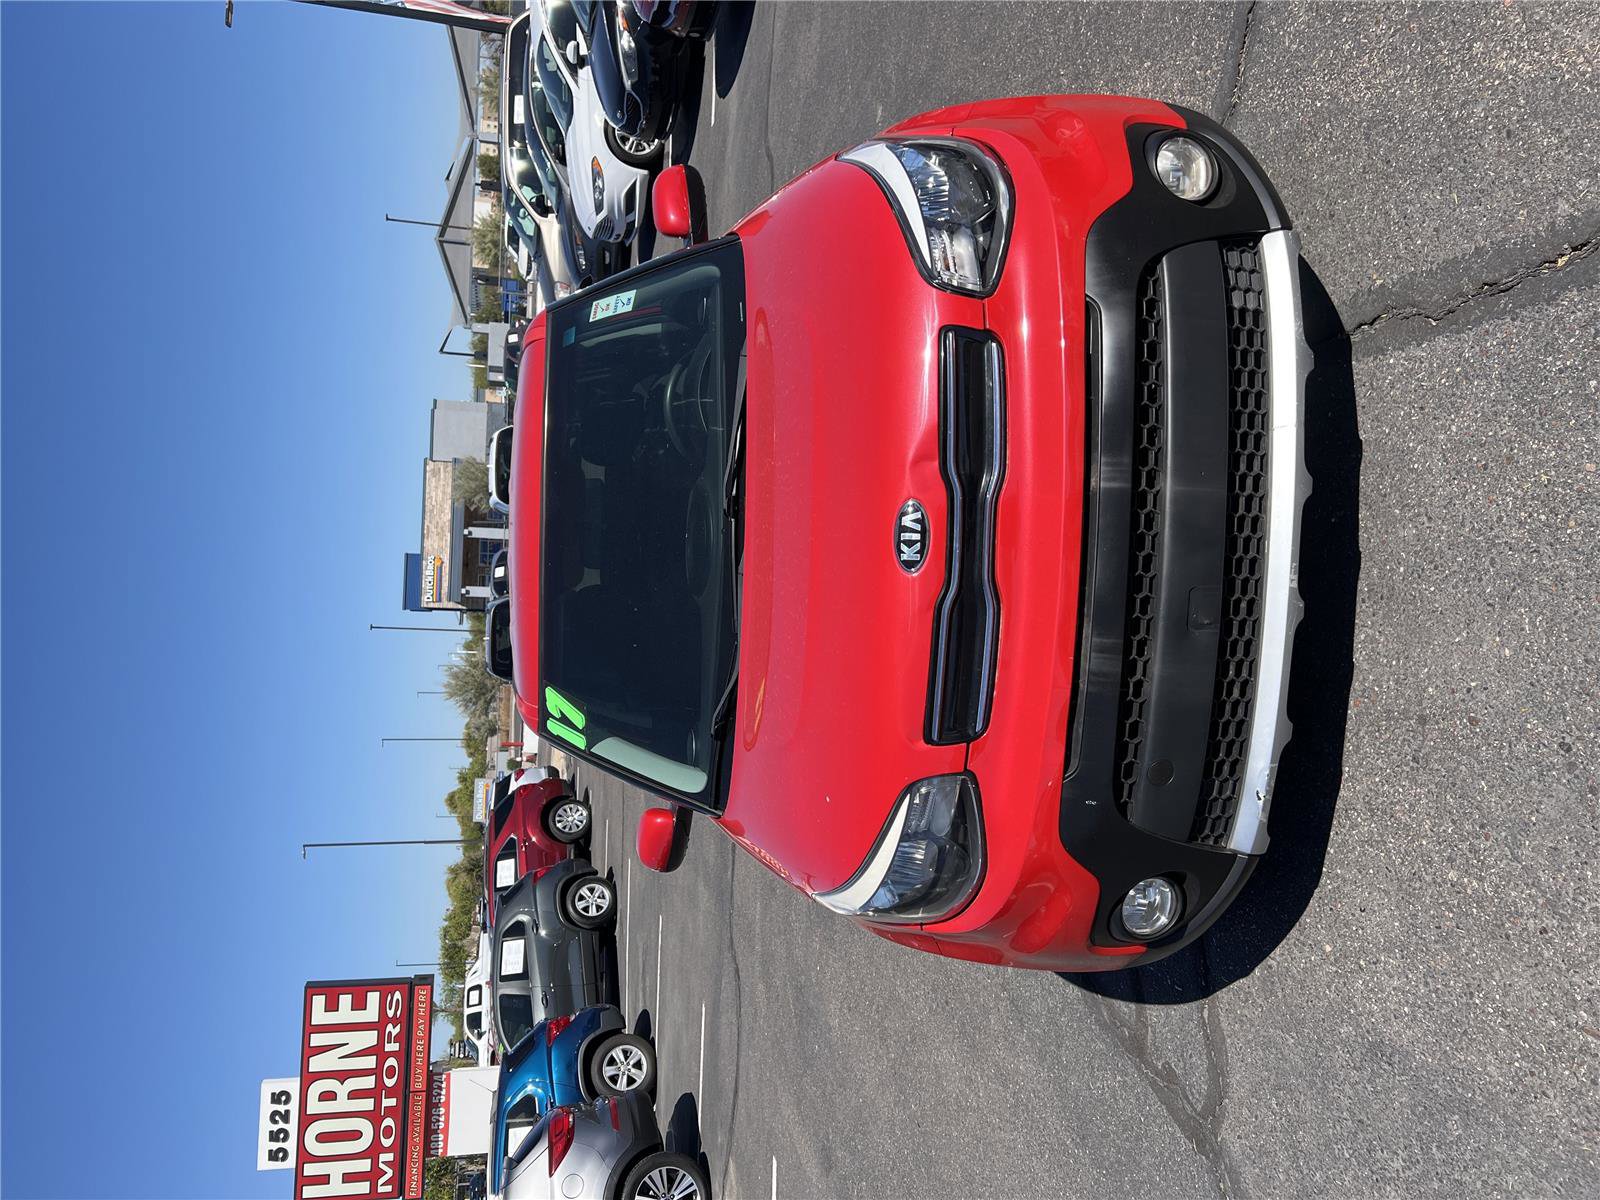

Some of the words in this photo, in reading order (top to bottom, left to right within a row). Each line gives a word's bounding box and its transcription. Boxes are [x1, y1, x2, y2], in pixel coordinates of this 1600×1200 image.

[545, 686, 587, 751] 17
[416, 1017, 426, 1036] PAY
[417, 988, 427, 1016] HERE
[414, 1067, 423, 1089] BUY
[415, 1039, 425, 1066] HERE
[301, 990, 380, 1200] HORNE
[378, 990, 402, 1193] MOTORS
[430, 1073, 447, 1156] 480-526-5224
[268, 1090, 292, 1163] 5525
[411, 1094, 423, 1143] AVAILABLE
[409, 1145, 420, 1196] FINANCING
